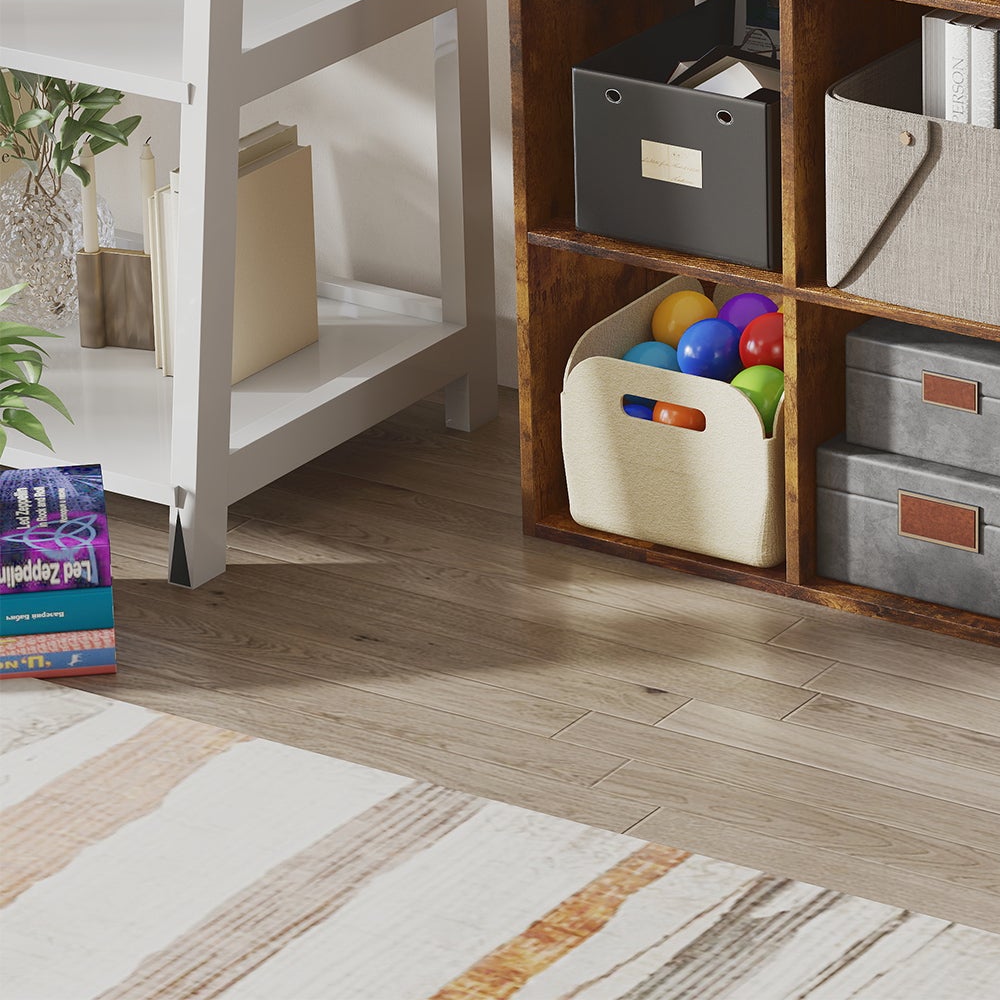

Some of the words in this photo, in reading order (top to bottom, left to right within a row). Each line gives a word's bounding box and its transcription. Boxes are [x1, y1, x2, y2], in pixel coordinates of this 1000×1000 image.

[16, 516, 30, 530] Led
[0, 558, 61, 588] Zeppelin
[63, 560, 91, 584] Led
